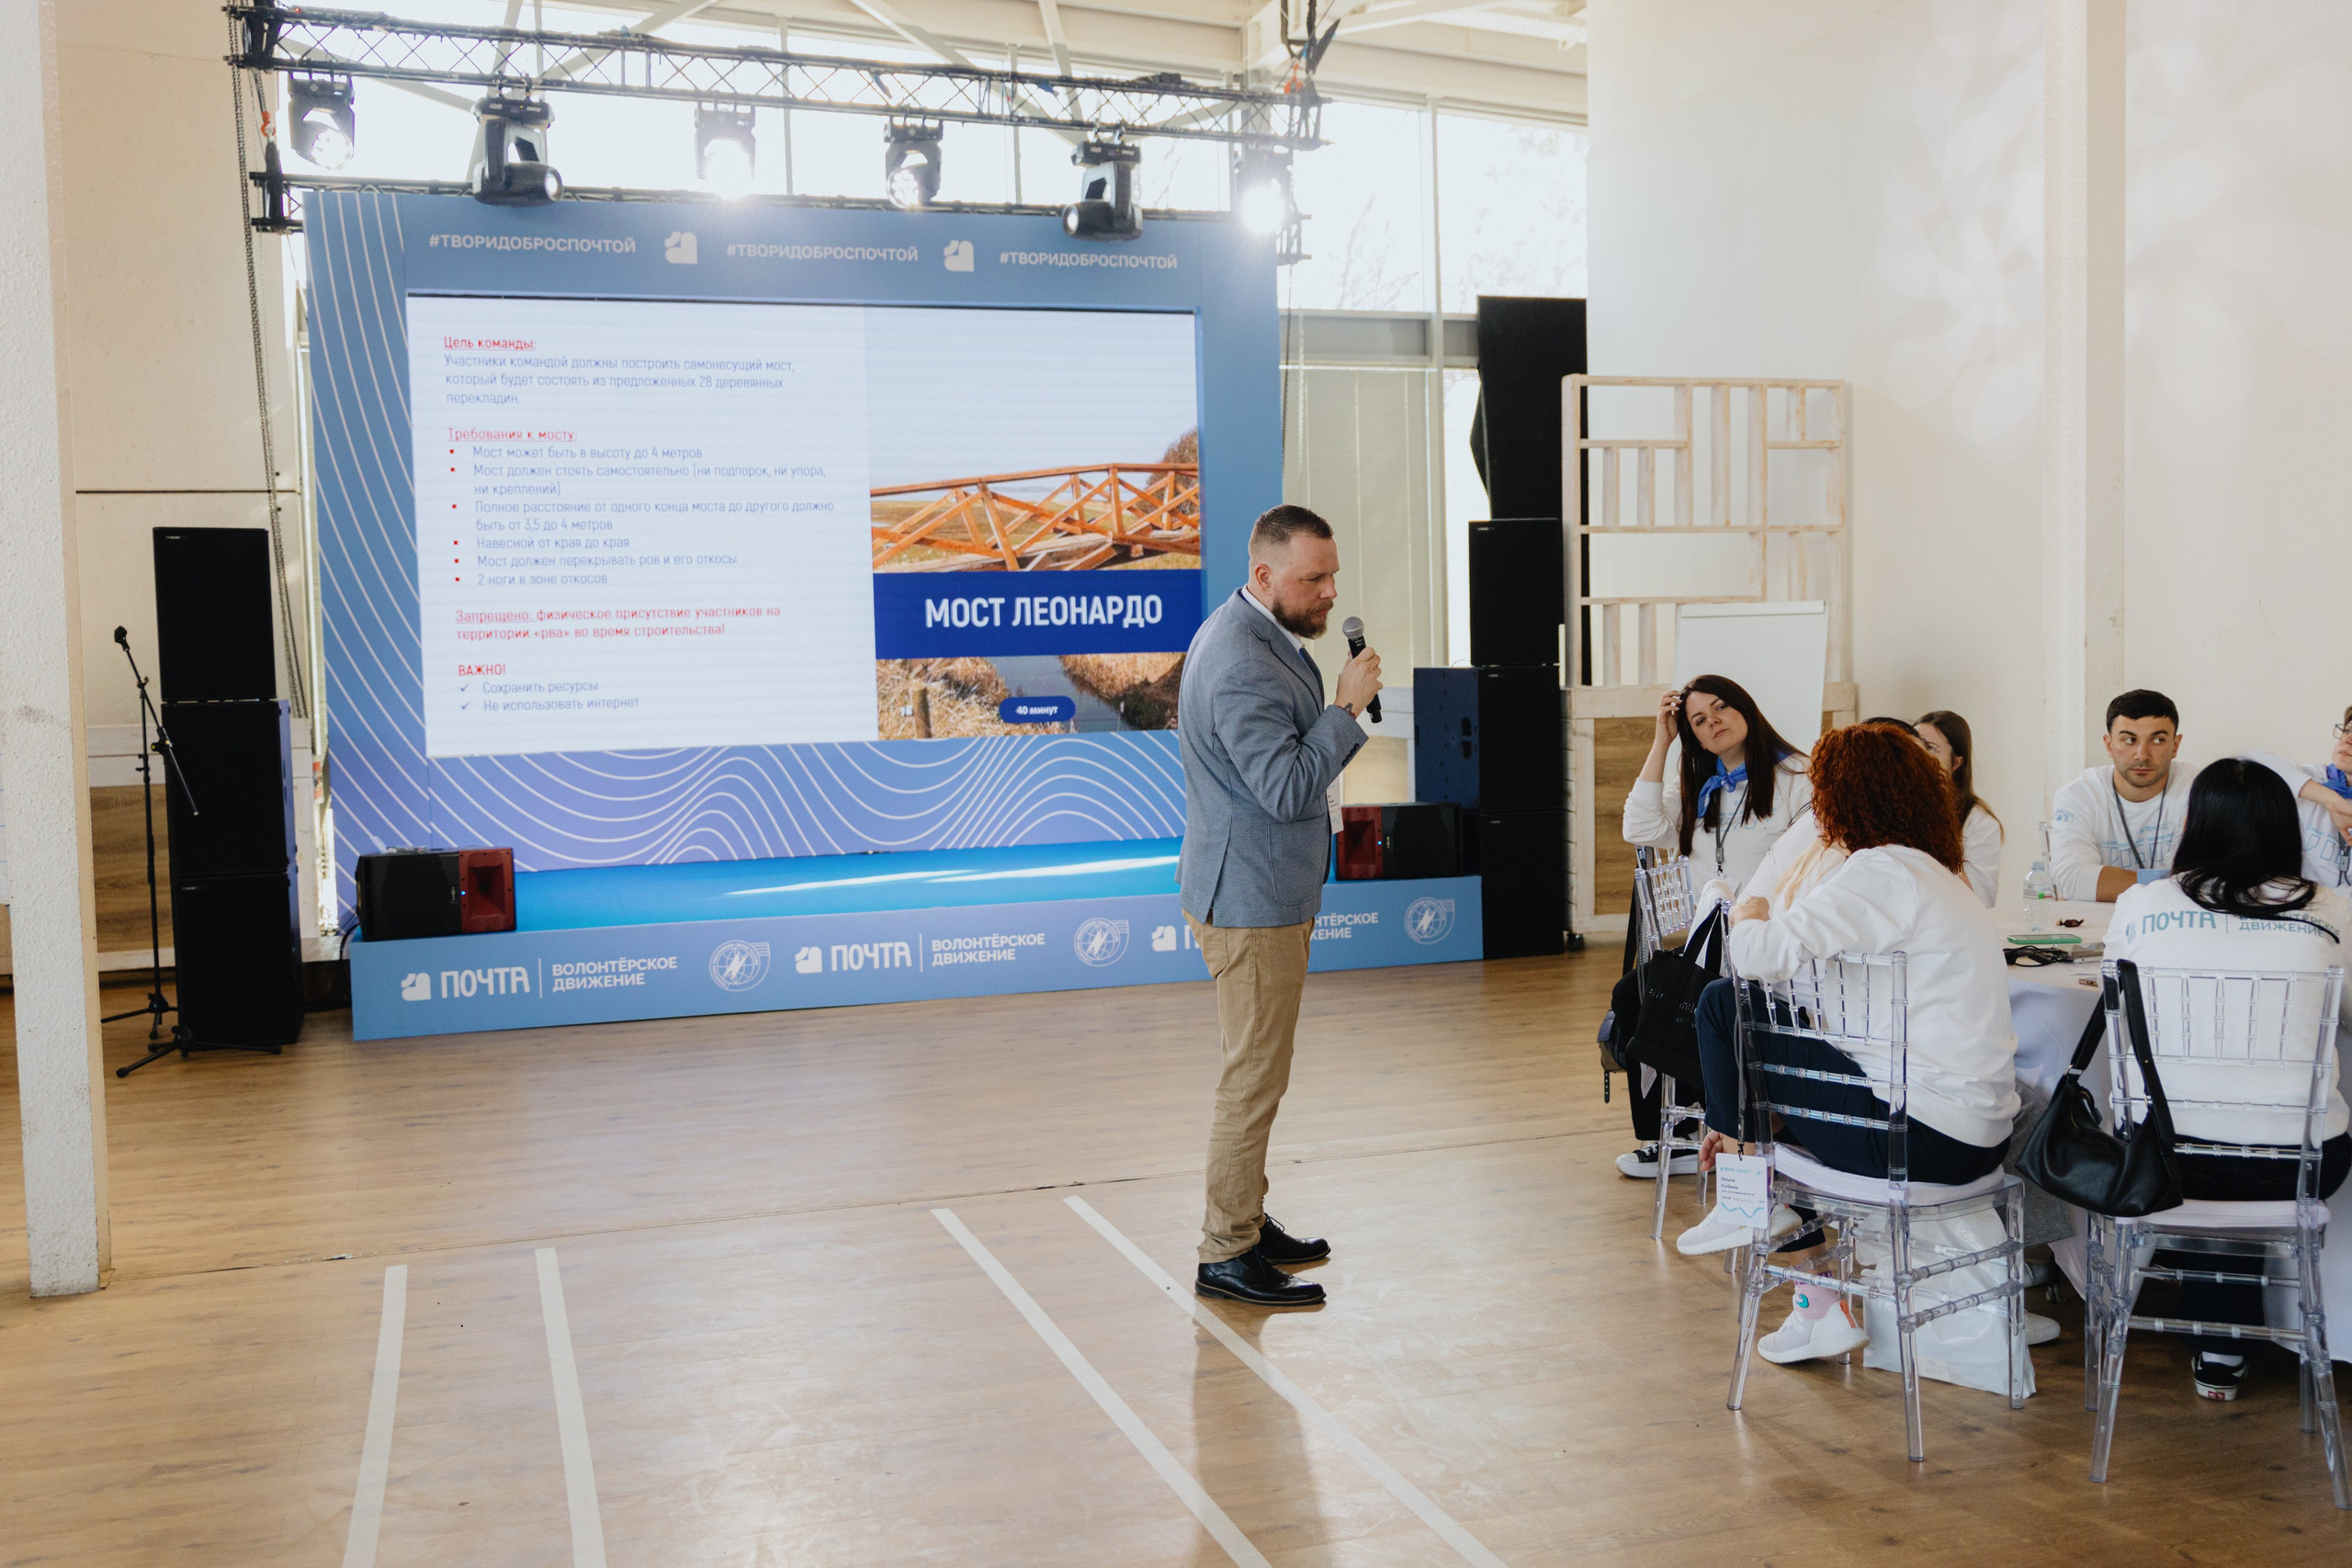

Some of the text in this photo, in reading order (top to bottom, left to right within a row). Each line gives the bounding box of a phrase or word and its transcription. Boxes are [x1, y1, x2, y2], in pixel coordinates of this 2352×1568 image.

[429, 233, 1177, 270] #ТВОРИДОБРОСПОЧТОЙ #ТВОРИДОБРОСПОЧТОЙ #ТВОРИДОБРОСПОЧТОЙ
[444, 336, 537, 350] Цель команды:
[444, 354, 506, 367] Участники
[510, 355, 569, 368] командой
[571, 358, 618, 369] должны
[621, 359, 681, 371] построить
[684, 358, 763, 372] самонесущий
[446, 373, 784, 389] который будет состоять из предложенных 28 деревянных
[448, 427, 578, 442] Требования к мосту:
[472, 446, 703, 460] Мост может быть в высоту до 4 метров
[473, 464, 503, 477] Мост
[506, 468, 552, 478] должен
[555, 468, 594, 477] стоять
[596, 467, 690, 476] самостоятельно
[714, 467, 772, 478] подпорок,
[774, 468, 788, 476] ни
[474, 486, 490, 494] ни
[475, 501, 834, 514] Полное расстояние от одного конца моста до другого должно
[476, 519, 614, 532] быть от 3,5 до 4 метров
[477, 536, 630, 549] Навесной от края до края
[477, 555, 738, 568] Мост должен перекрывать ров и его откосы
[478, 573, 608, 585] 2 ноги в зоне откосов
[456, 611, 532, 622] Запрещено:
[536, 609, 612, 621] физическое
[616, 610, 691, 620] присутствие
[695, 608, 763, 619] участников
[925, 594, 1162, 628] МОСТ ЛЕОНАРДО
[457, 626, 725, 641] территории «рва» во время строительства!
[458, 664, 506, 676] ВАЖНО!
[482, 682, 599, 694] Сохранить ресурсы
[483, 698, 639, 711] Не использовать интернет
[1016, 705, 1058, 716] 40 минут
[1315, 912, 1378, 927] НТЁРСКОЕ
[2142, 910, 2217, 934] ПОЧТА
[2239, 921, 2324, 938] ДВИЖЕНИЕ
[831, 941, 912, 971] ПОЧТА
[932, 932, 1046, 952] ВОЛОНТЁРСКОЕ
[932, 948, 1016, 967] ДВИЖЕНИЕ
[441, 965, 530, 998] ПОЧТА
[552, 955, 678, 976] ВОЛОНТЁРСКОЕ
[552, 973, 646, 993] ДВИЖЕНИЕ
